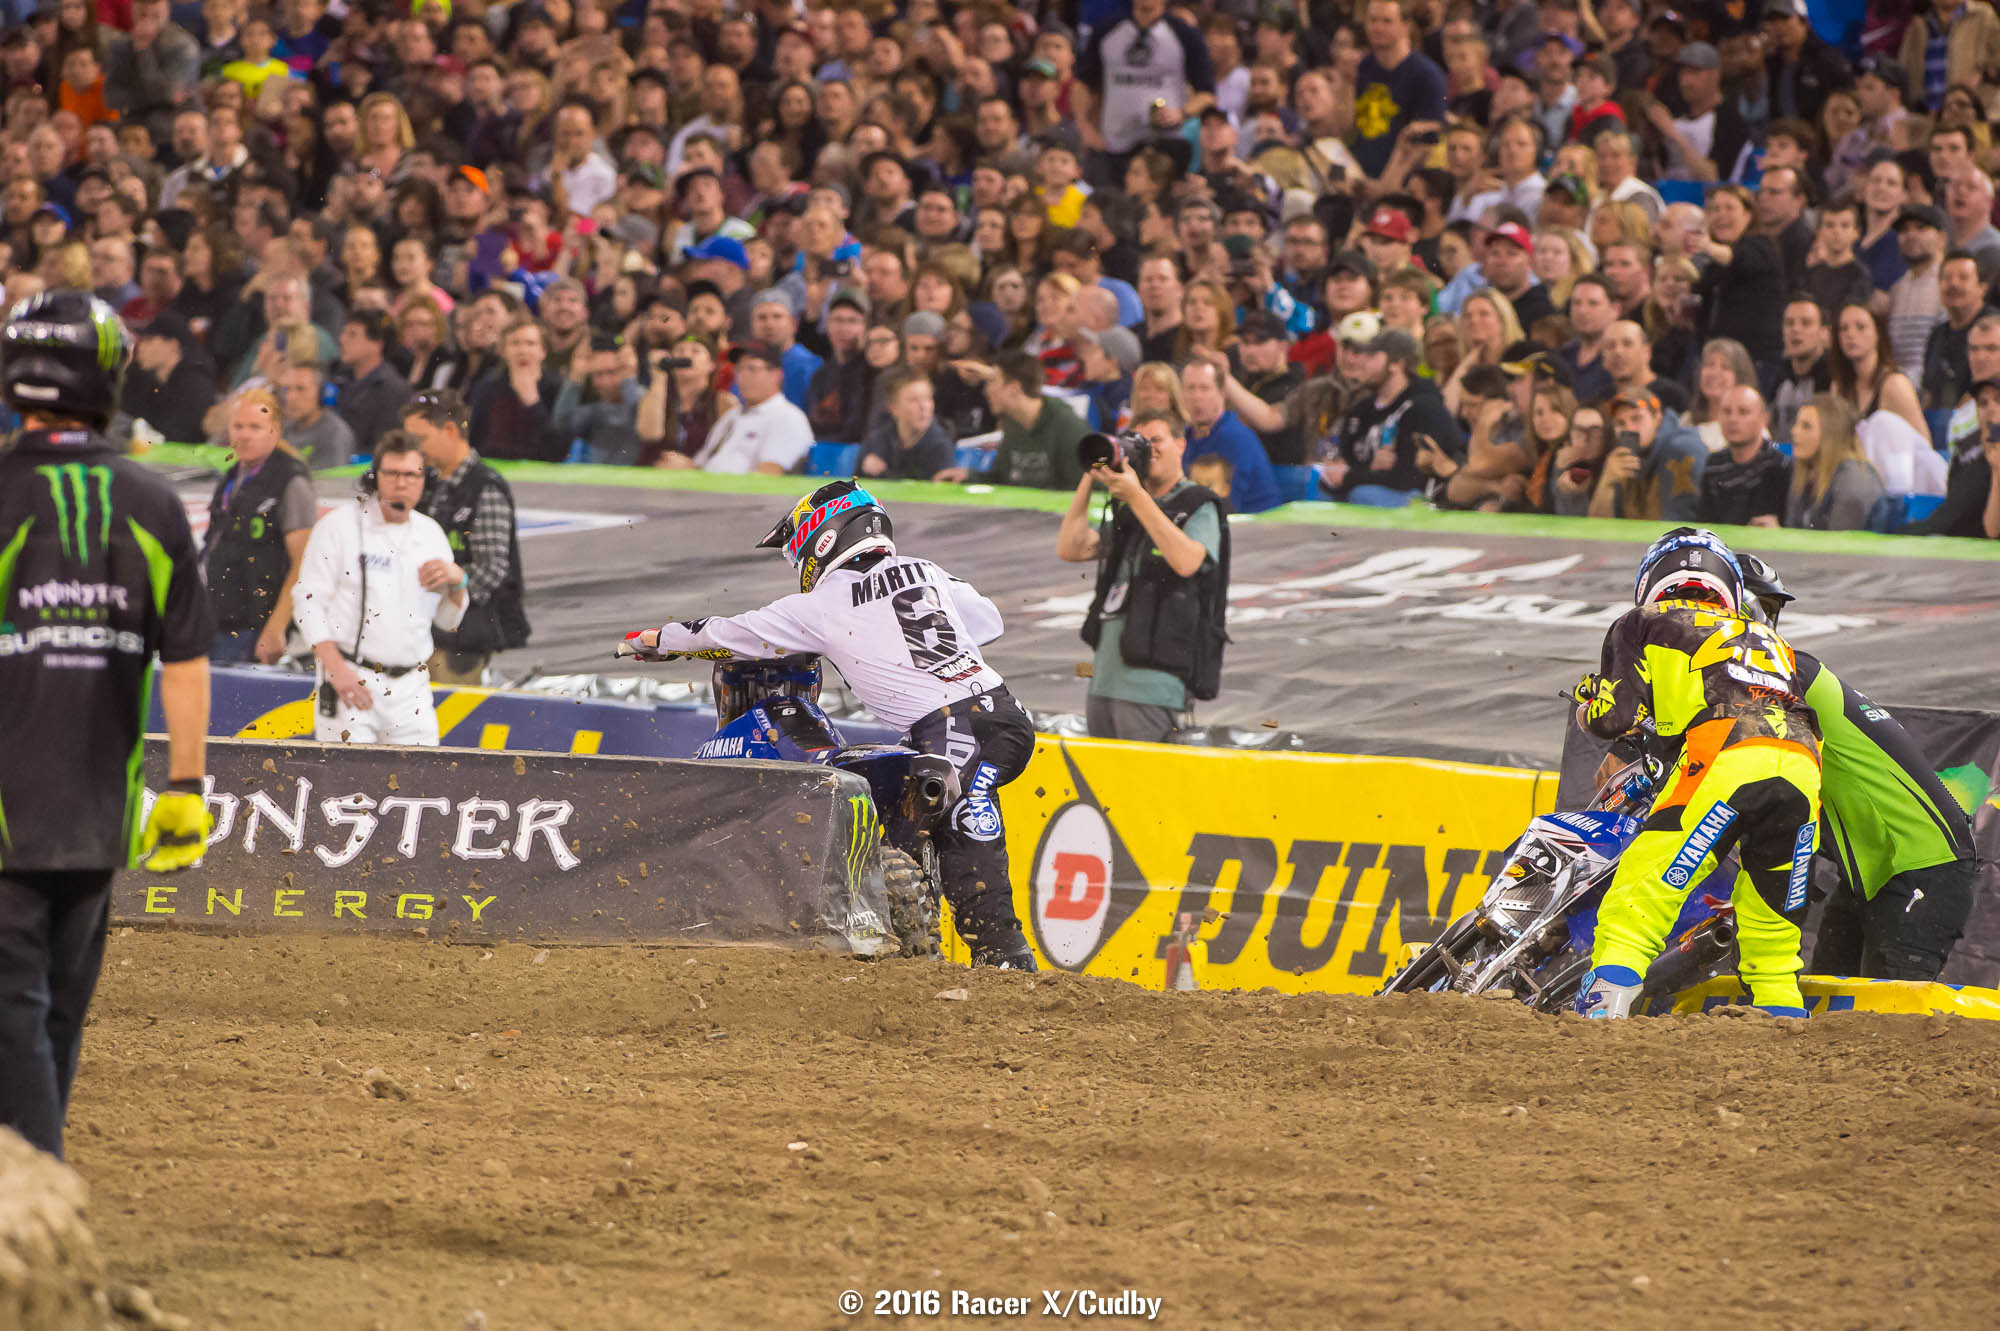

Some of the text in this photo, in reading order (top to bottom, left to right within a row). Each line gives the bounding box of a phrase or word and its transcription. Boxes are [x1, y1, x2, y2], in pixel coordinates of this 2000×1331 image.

[789, 495, 852, 558] 100%
[817, 535, 834, 553] BELL
[19, 579, 128, 610] MONSTR
[892, 585, 959, 670] 6
[1689, 611, 1793, 682] 23
[755, 708, 772, 729] GYTR
[782, 707, 797, 716] 6
[702, 736, 744, 758] YAMAHA
[139, 775, 582, 872] ONSTER
[1552, 812, 1603, 833] YAMAHA
[1676, 804, 1736, 870] YAMAHA
[1044, 852, 1106, 921] D
[1787, 843, 1812, 910] YAMAHA
[145, 886, 497, 922] ENERGY
